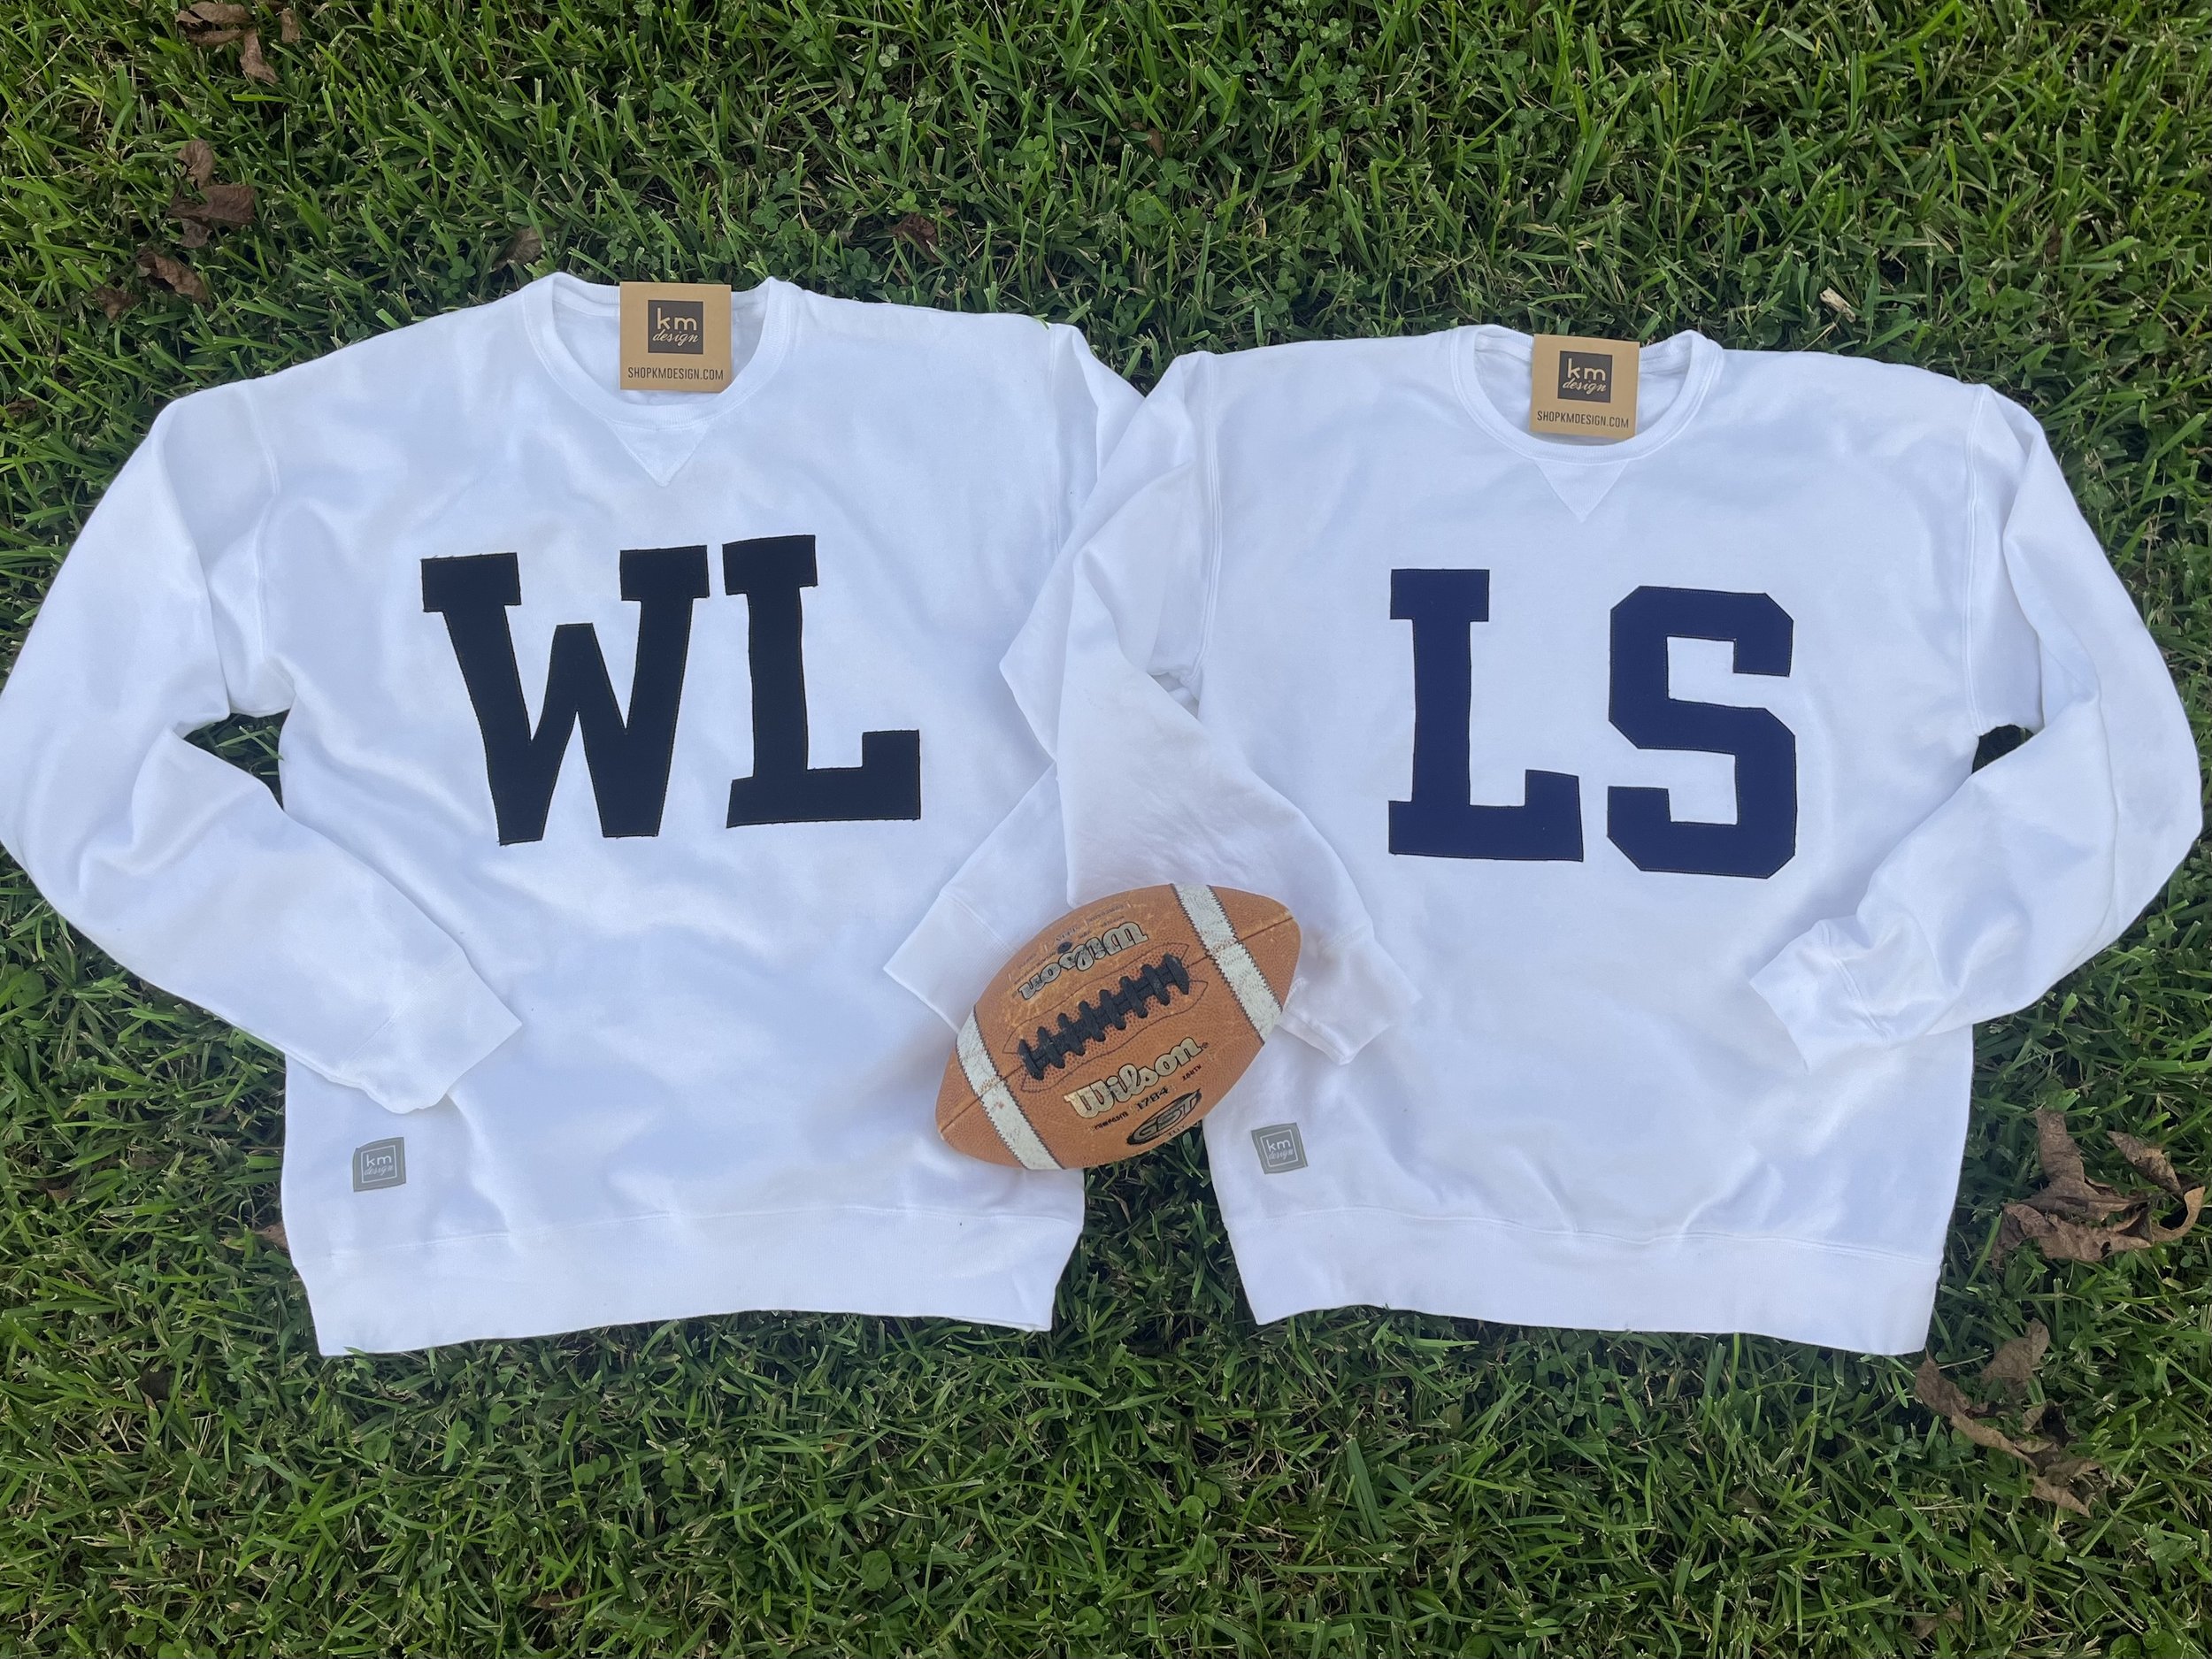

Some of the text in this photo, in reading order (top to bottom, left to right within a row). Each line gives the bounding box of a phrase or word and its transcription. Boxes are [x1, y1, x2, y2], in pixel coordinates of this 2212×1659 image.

[657, 307, 697, 331] km
[652, 328, 699, 347] design
[627, 366, 724, 380] SHOPKMDESIGN.COM
[1567, 357, 1606, 381] km
[1562, 378, 1607, 395] design
[1537, 410, 1629, 428] SHOPKMDESIGN.COM
[420, 534, 921, 846] WL
[1388, 568, 1798, 879] LS
[1018, 921, 1149, 1001] Wilson
[1063, 1036, 1203, 1118] Wilson
[1136, 1086, 1169, 1111] 1784
[1132, 1092, 1200, 1141] GST
[1265, 1139, 1291, 1153] km
[365, 1154, 392, 1167] km
